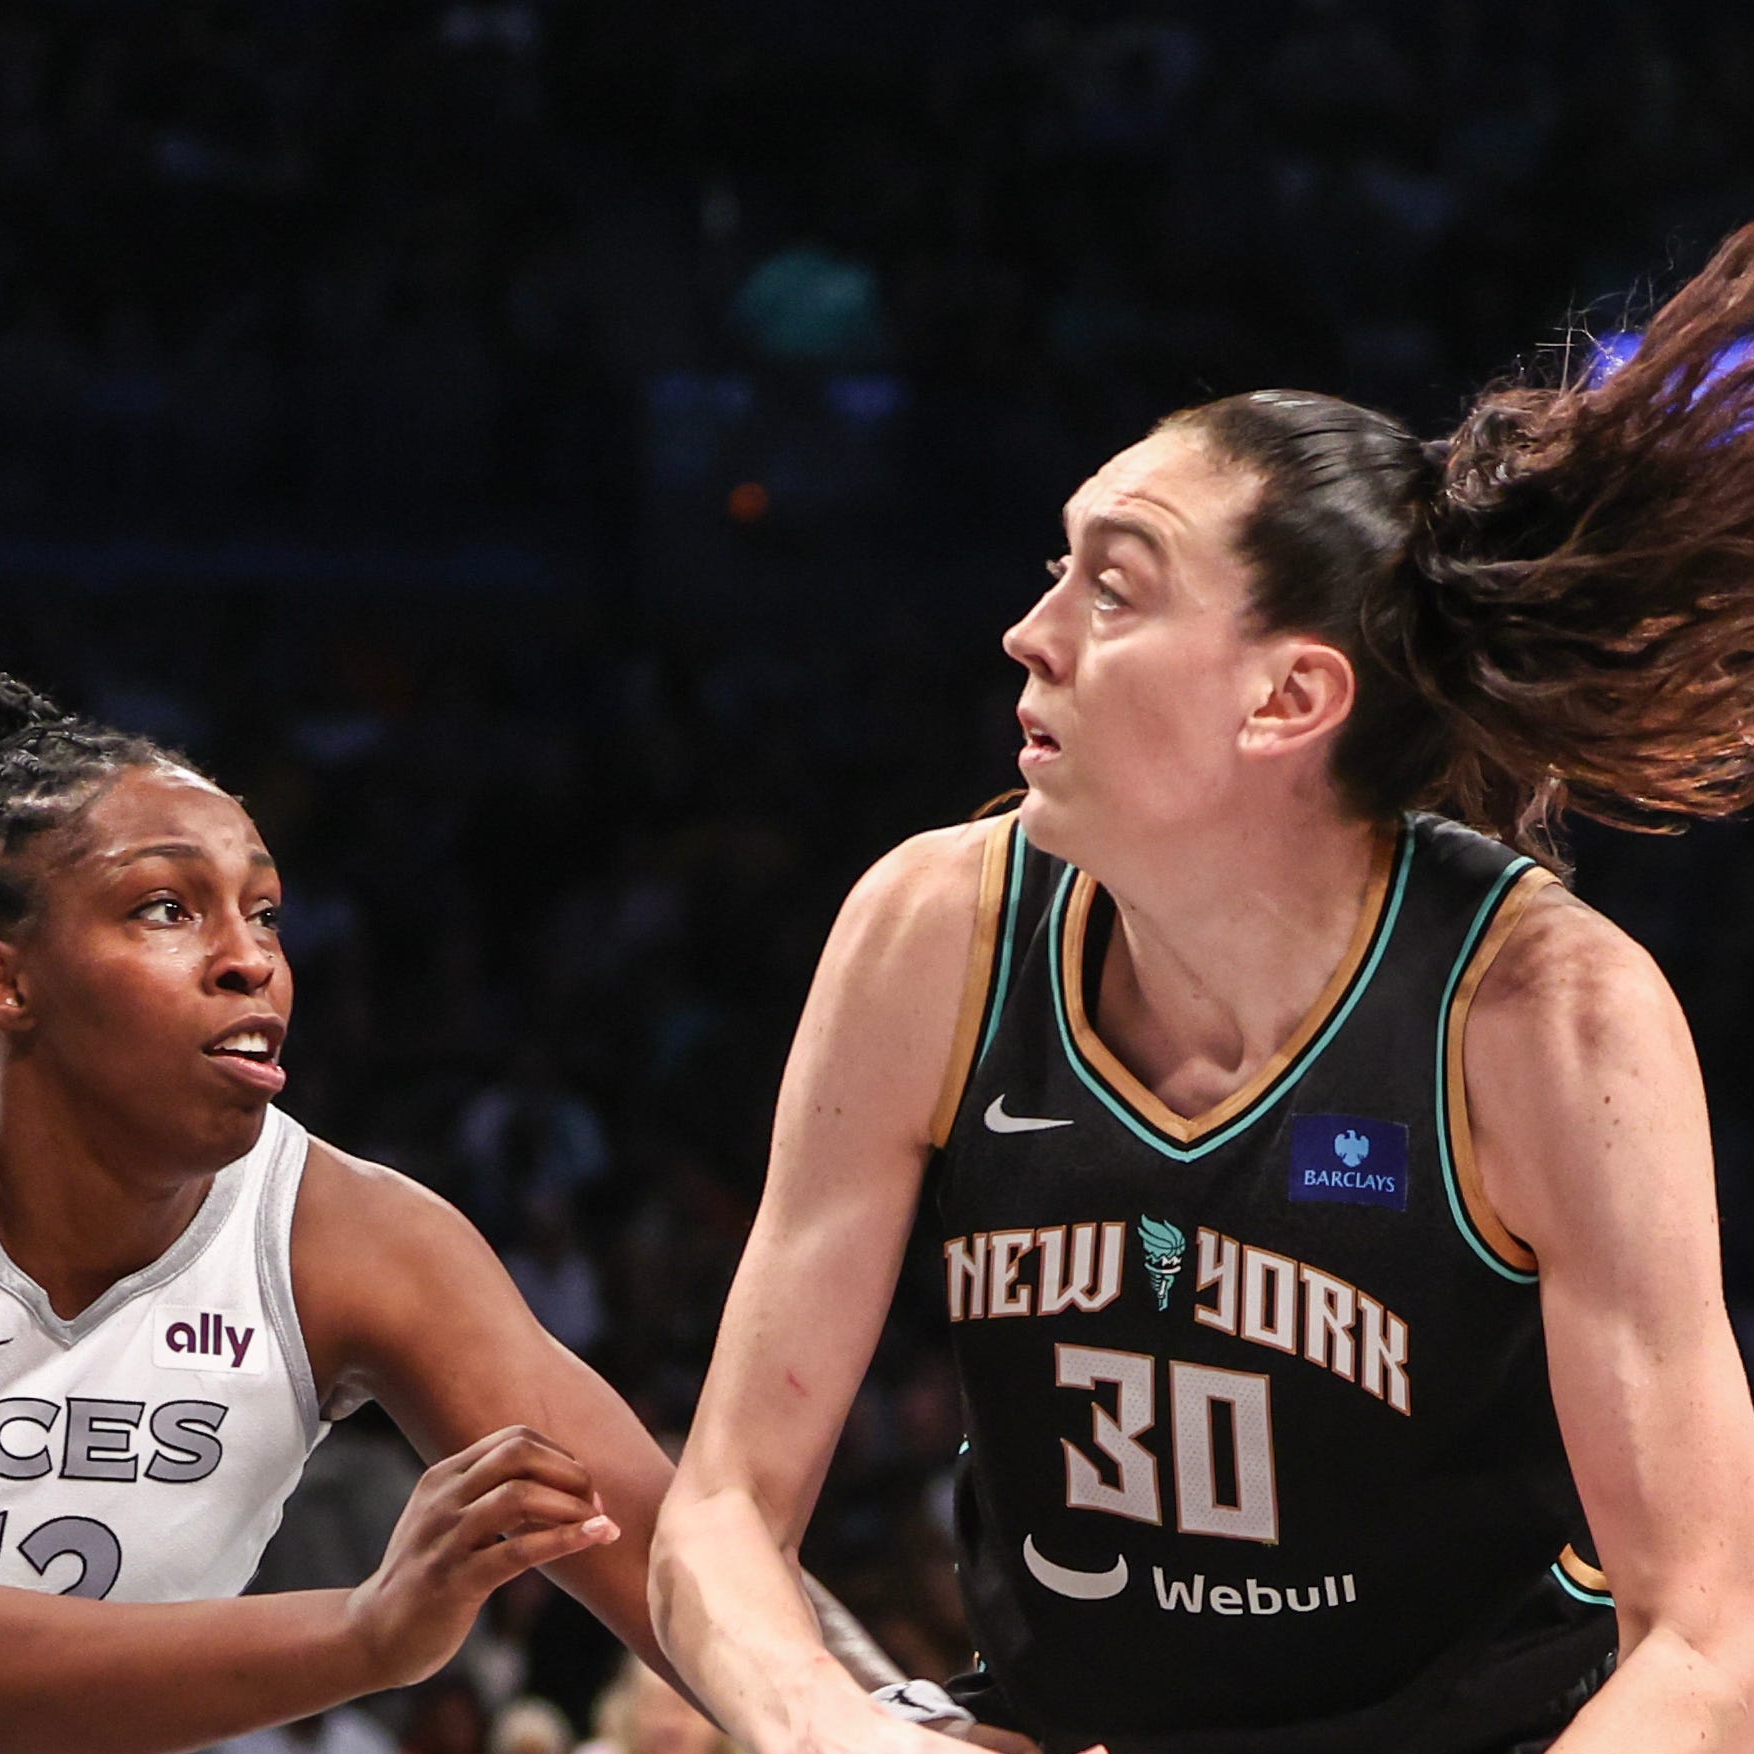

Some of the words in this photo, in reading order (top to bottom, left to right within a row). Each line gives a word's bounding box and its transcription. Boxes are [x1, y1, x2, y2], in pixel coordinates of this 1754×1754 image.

[1304, 1169, 1395, 1193] BARCLAYS
[165, 1312, 255, 1368] ally
[945, 1221, 1126, 1321] NEW
[1194, 1226, 1411, 1416] YORK
[1054, 1342, 1279, 1546] 30
[1152, 1566, 1357, 1616] Webull
